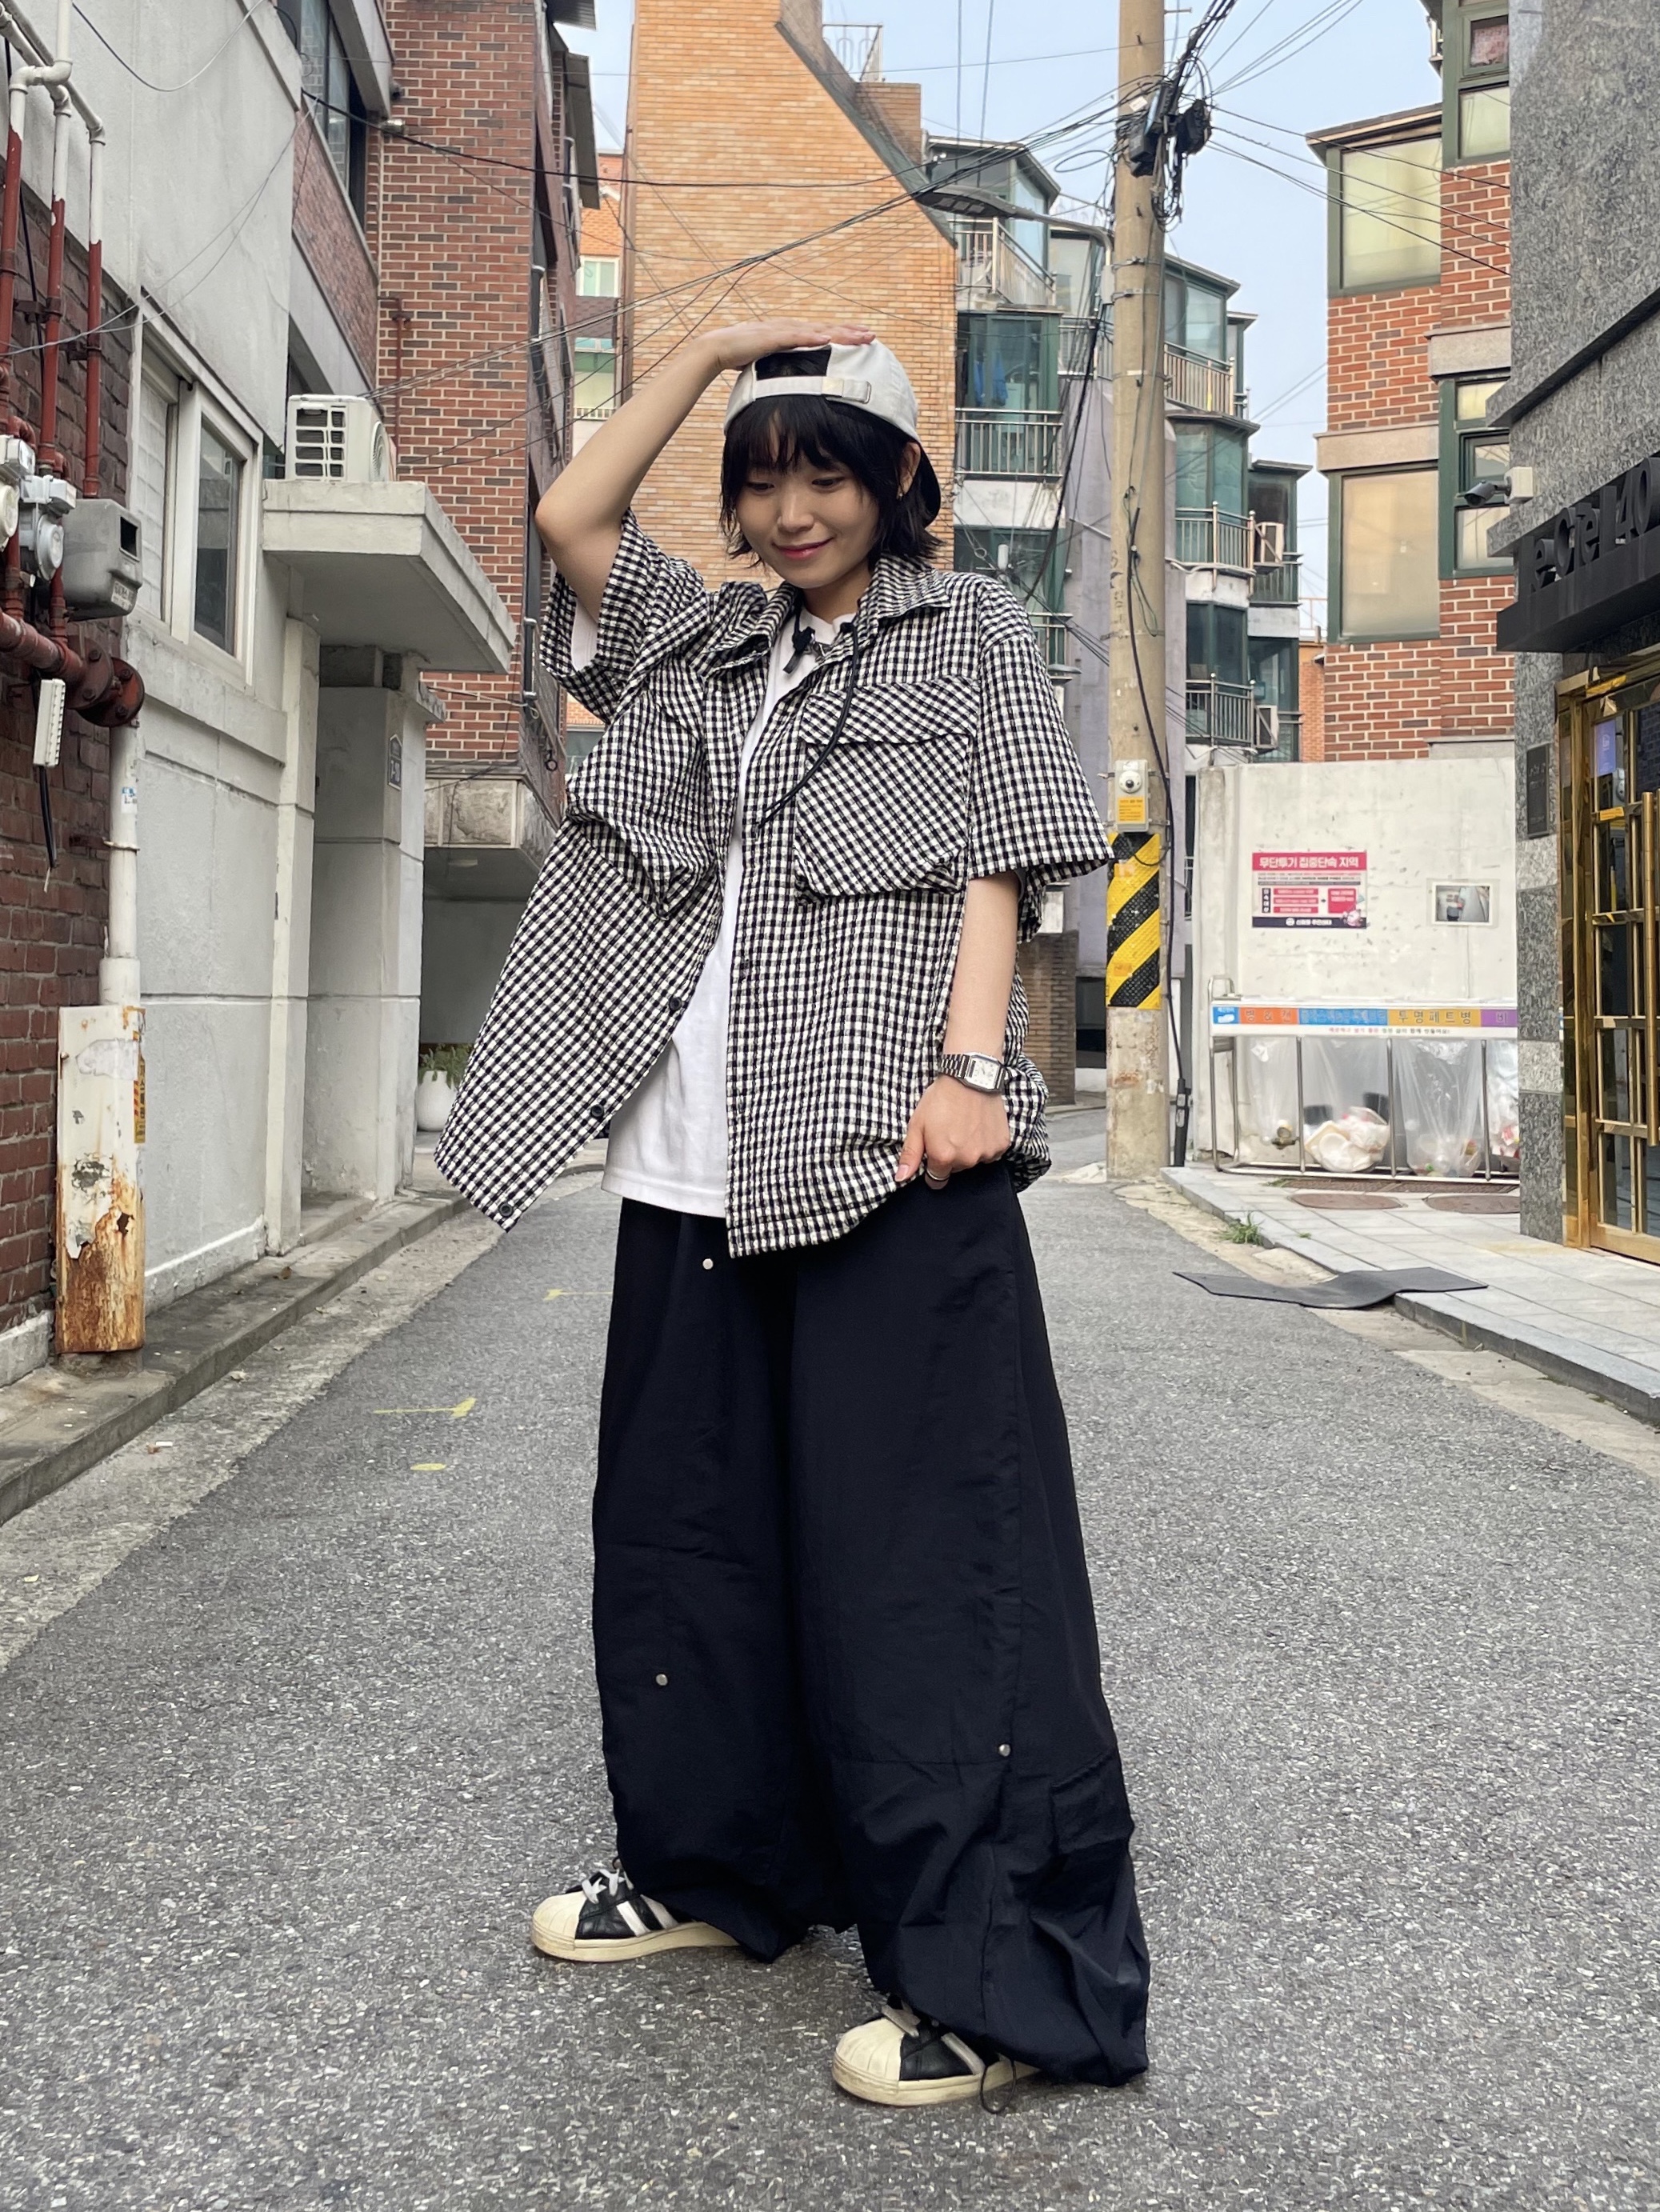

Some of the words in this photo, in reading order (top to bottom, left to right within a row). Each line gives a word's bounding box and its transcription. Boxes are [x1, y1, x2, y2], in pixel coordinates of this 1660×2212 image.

[1259, 856, 1298, 869] 무단투기
[1299, 856, 1338, 869] 집중단속
[1338, 856, 1359, 868] 지역
[1245, 1010, 1255, 1022] 병
[1263, 1010, 1274, 1022] &
